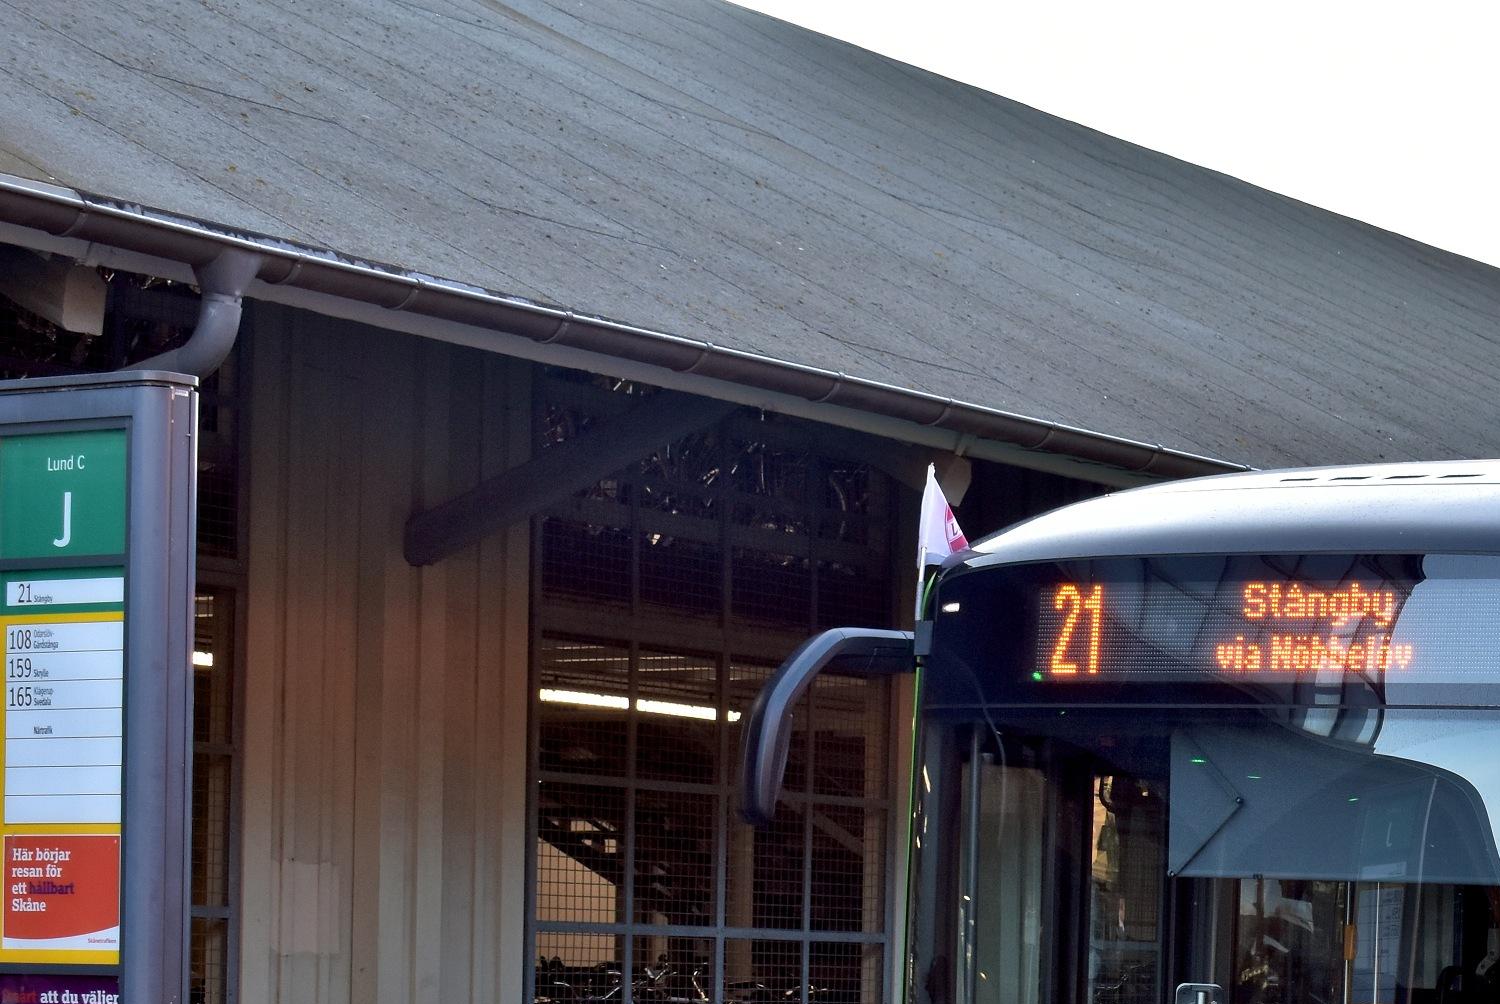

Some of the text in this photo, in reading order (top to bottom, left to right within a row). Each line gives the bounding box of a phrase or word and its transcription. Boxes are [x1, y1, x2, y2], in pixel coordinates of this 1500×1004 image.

[47, 454, 86, 471] Lund C
[52, 491, 72, 548] J
[18, 583, 32, 603] 21
[1243, 583, 1393, 627] Stångby
[1051, 584, 1102, 674] 21
[10, 629, 32, 650] 108
[1216, 635, 1412, 669] via Nöbbelöv
[9, 658, 32, 678] 159
[9, 686, 32, 707] 165
[13, 848, 71, 863] Här börjar
[12, 864, 62, 878] resan för
[12, 881, 74, 895] ett hållbart
[12, 897, 46, 912] Skåne
[40, 990, 59, 1004] att
[61, 989, 79, 1004] du
